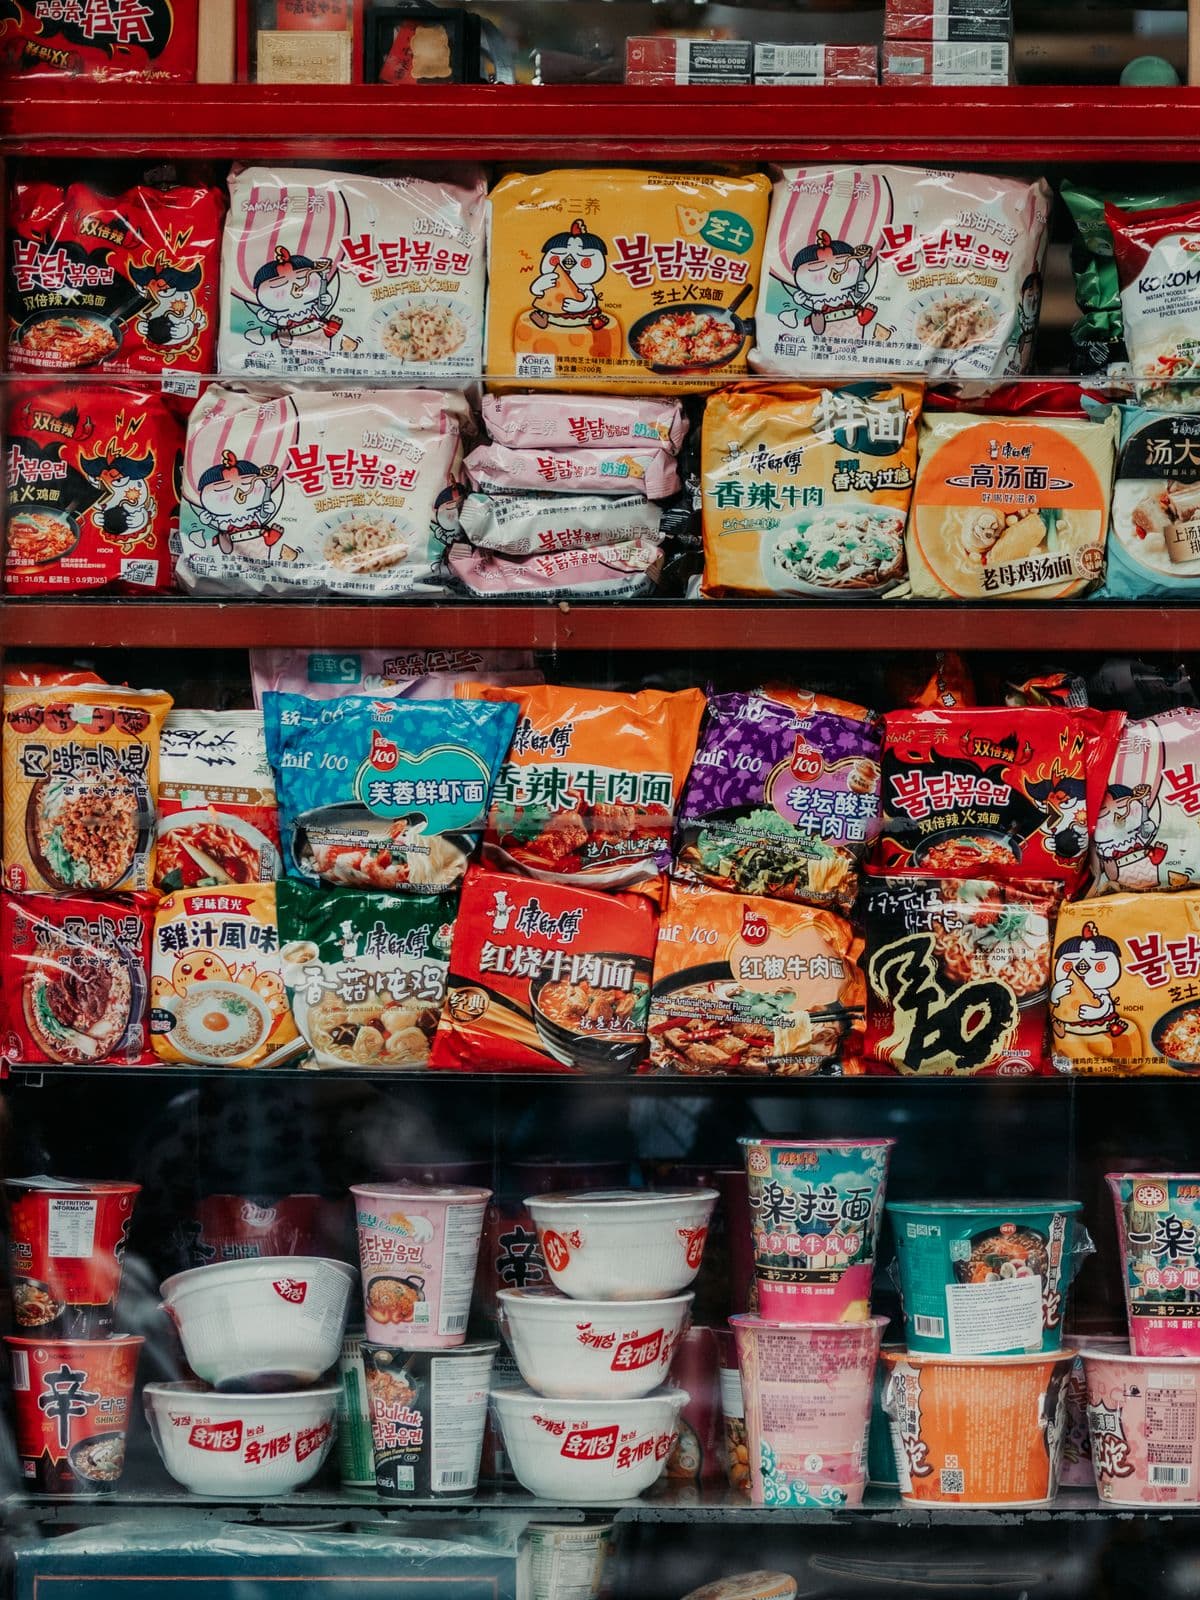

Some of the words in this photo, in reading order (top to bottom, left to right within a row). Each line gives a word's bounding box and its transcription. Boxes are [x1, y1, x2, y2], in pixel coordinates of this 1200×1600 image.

[11, 240, 115, 291] 불닭볶음면
[338, 234, 473, 285] 불닭볶음면
[610, 234, 750, 288] 불닭볶음면
[651, 284, 724, 306] 芝士火鸡面
[970, 464, 1050, 489] 高汤面
[709, 481, 825, 512] 香辣牛肉
[982, 553, 1072, 591] 老母鸡汤面
[371, 750, 396, 764] 100
[973, 739, 1015, 762] 双倍辣
[794, 757, 819, 774] 100
[368, 779, 486, 806] 芙蓉鲜虾面
[788, 787, 880, 818] 老坛酸菜
[891, 770, 1011, 820] 불닭볶음면
[799, 813, 866, 840] 牛肉面
[918, 809, 1000, 835] 双倍辣火鸡面
[191, 897, 242, 910] 享味食光
[516, 897, 582, 943] 康師傅
[743, 924, 766, 938] 100
[158, 922, 279, 953] 雞汁風味
[366, 921, 429, 960] 康師傅
[480, 940, 636, 991] 红烧牛肉面
[740, 955, 844, 980] 红椒牛肉面
[295, 965, 444, 1006] 香菇炖鸡
[451, 992, 484, 1009] 经典
[615, 1337, 658, 1368] 육개장
[38, 1364, 100, 1450] 辛
[99, 1397, 127, 1412] 라면
[375, 1399, 422, 1426] Buldak
[190, 1425, 240, 1449] 육개장
[244, 1434, 291, 1465] 육개장
